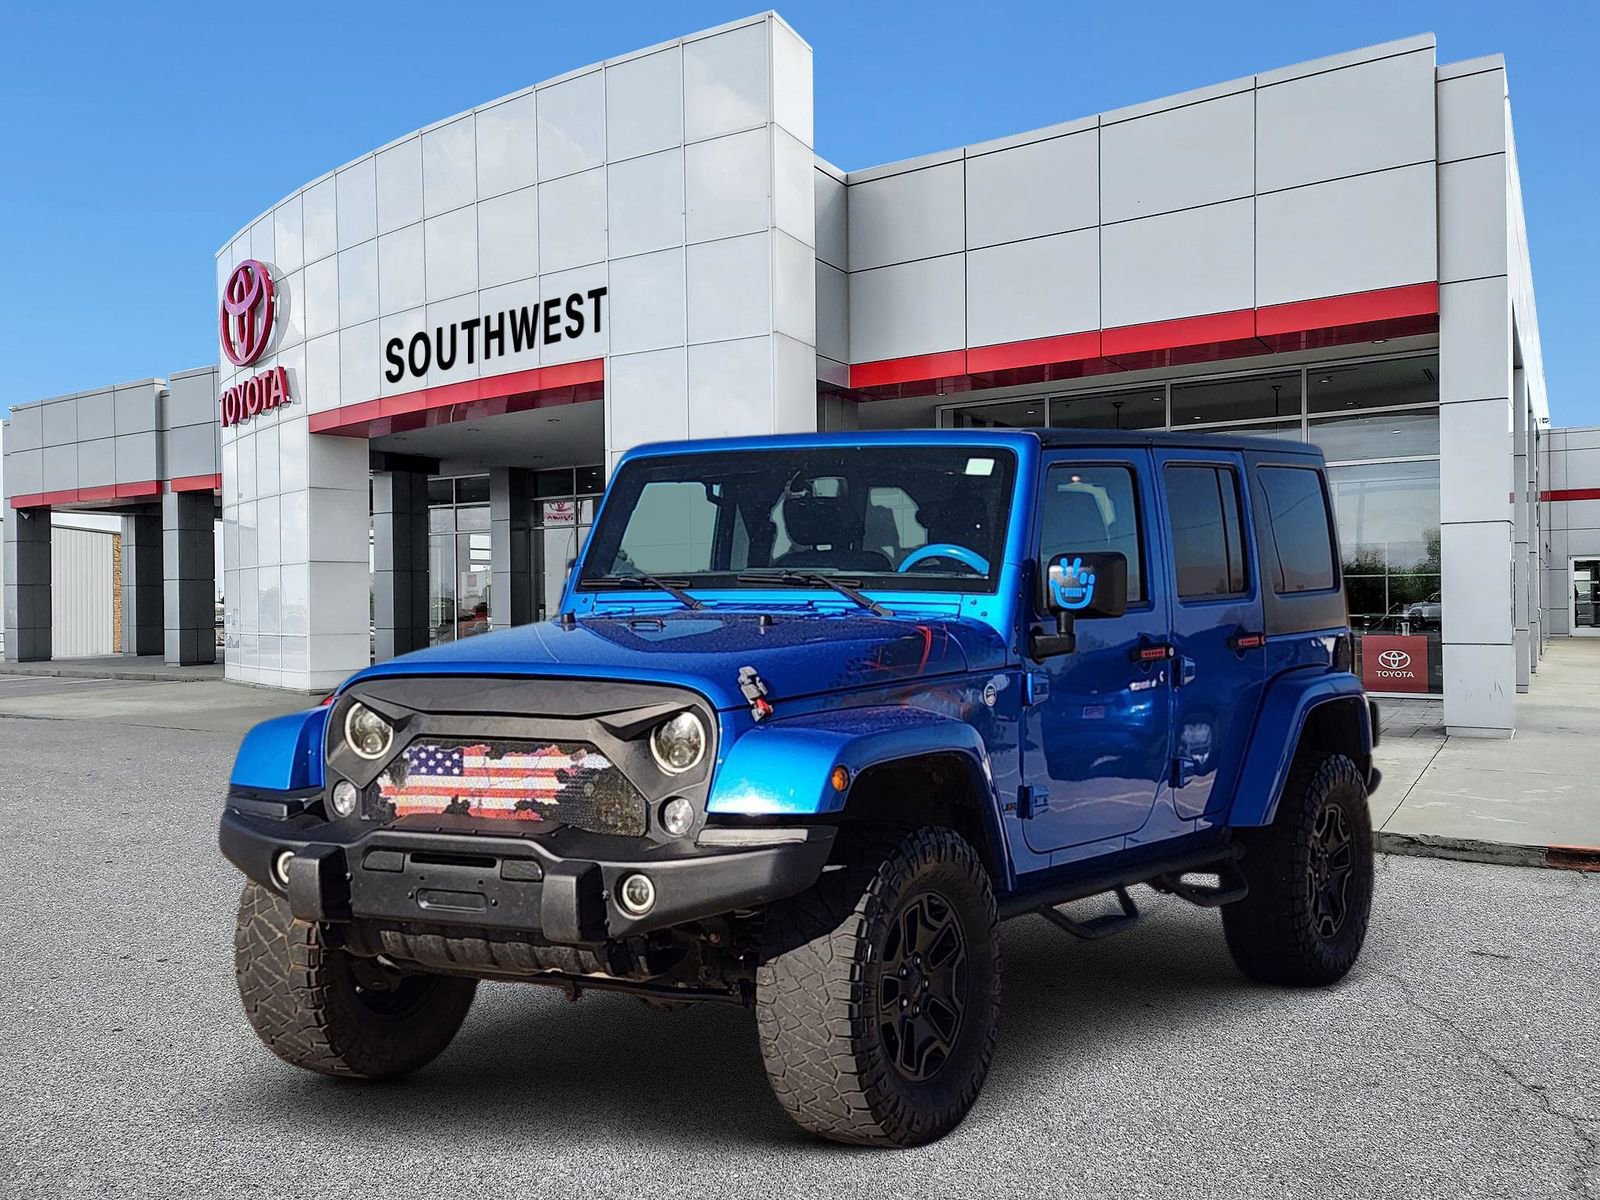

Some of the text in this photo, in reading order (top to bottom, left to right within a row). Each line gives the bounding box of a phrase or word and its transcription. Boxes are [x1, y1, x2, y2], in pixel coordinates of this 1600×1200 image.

[385, 286, 607, 383] SOUTHWEST
[219, 366, 290, 427] TOYOTA
[1375, 670, 1415, 678] TOYOTA
